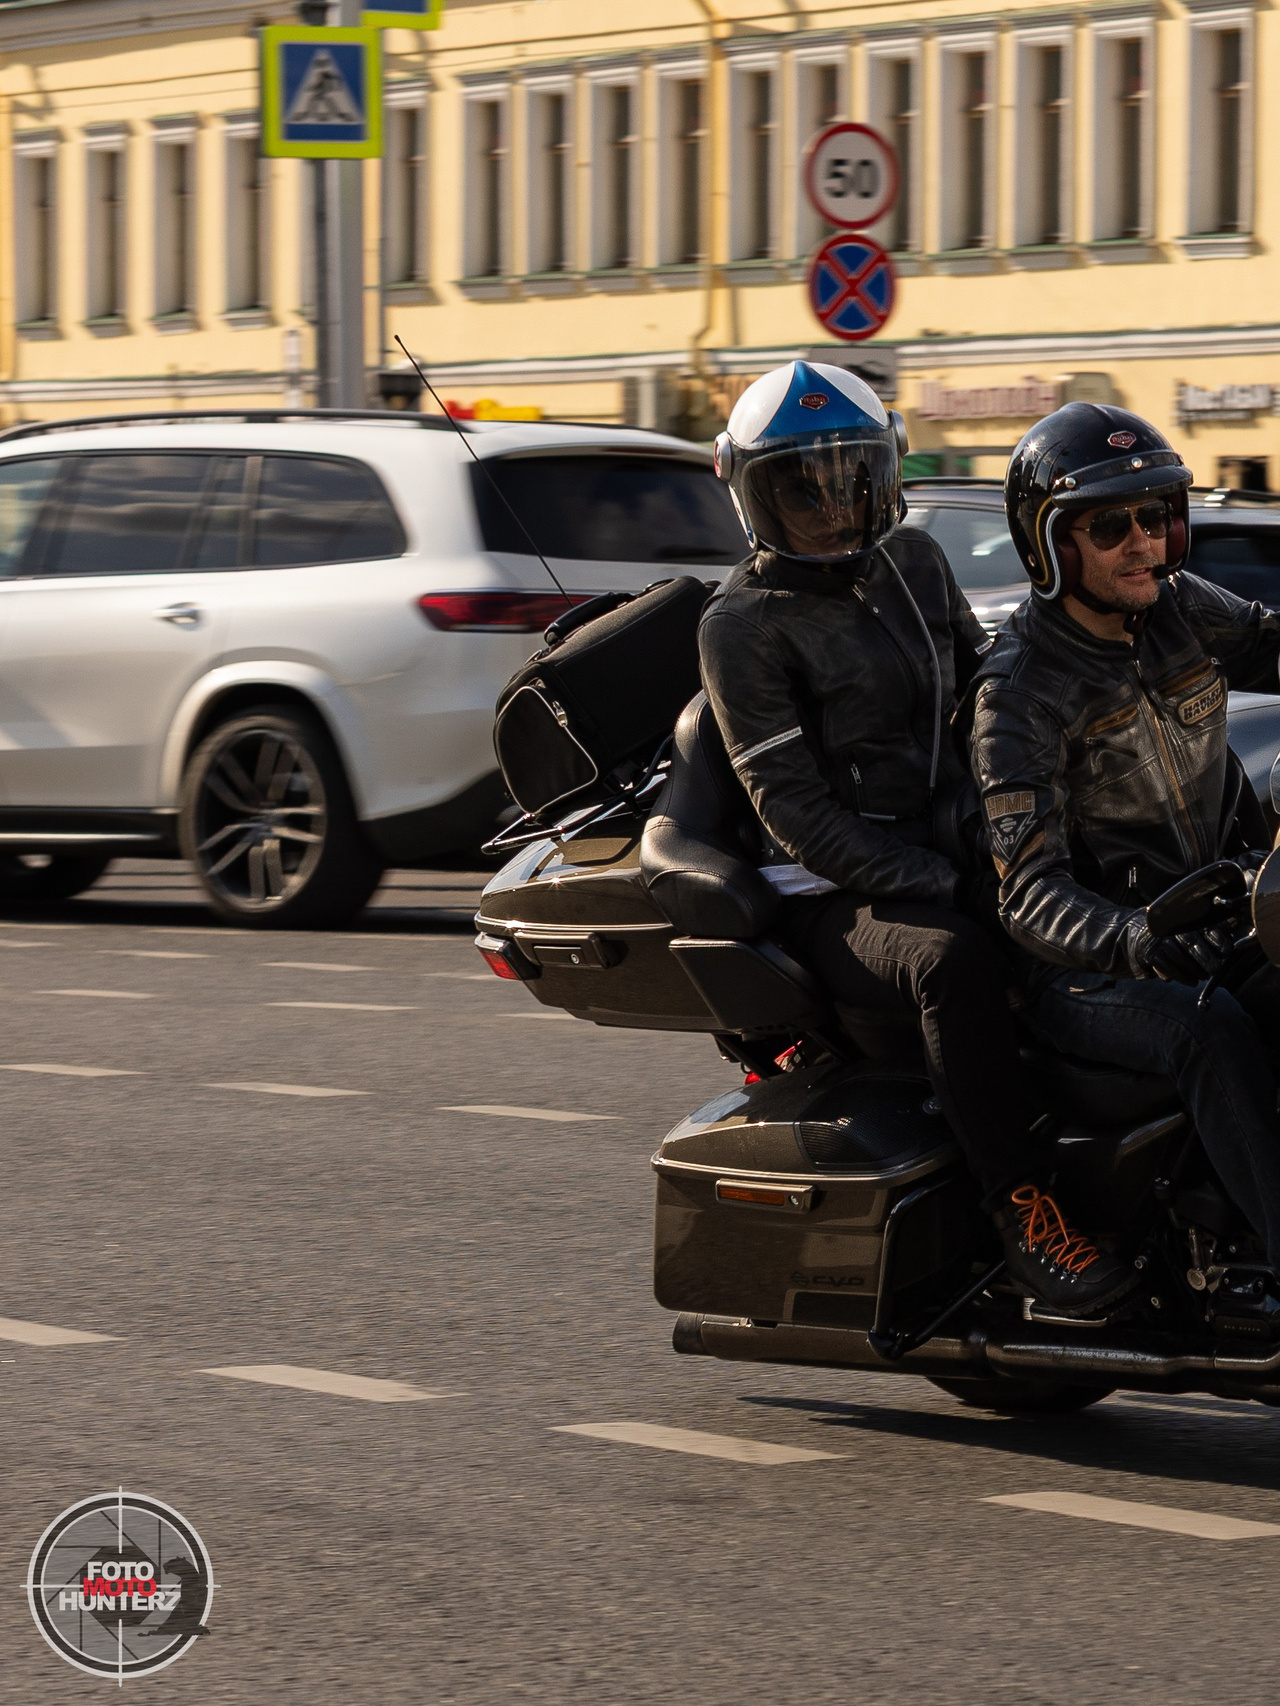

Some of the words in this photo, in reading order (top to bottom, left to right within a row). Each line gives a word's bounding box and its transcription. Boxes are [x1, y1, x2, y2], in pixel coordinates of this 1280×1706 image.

[824, 159, 880, 199] 50
[985, 790, 1033, 820] HDMC
[1004, 835, 1014, 846] 03
